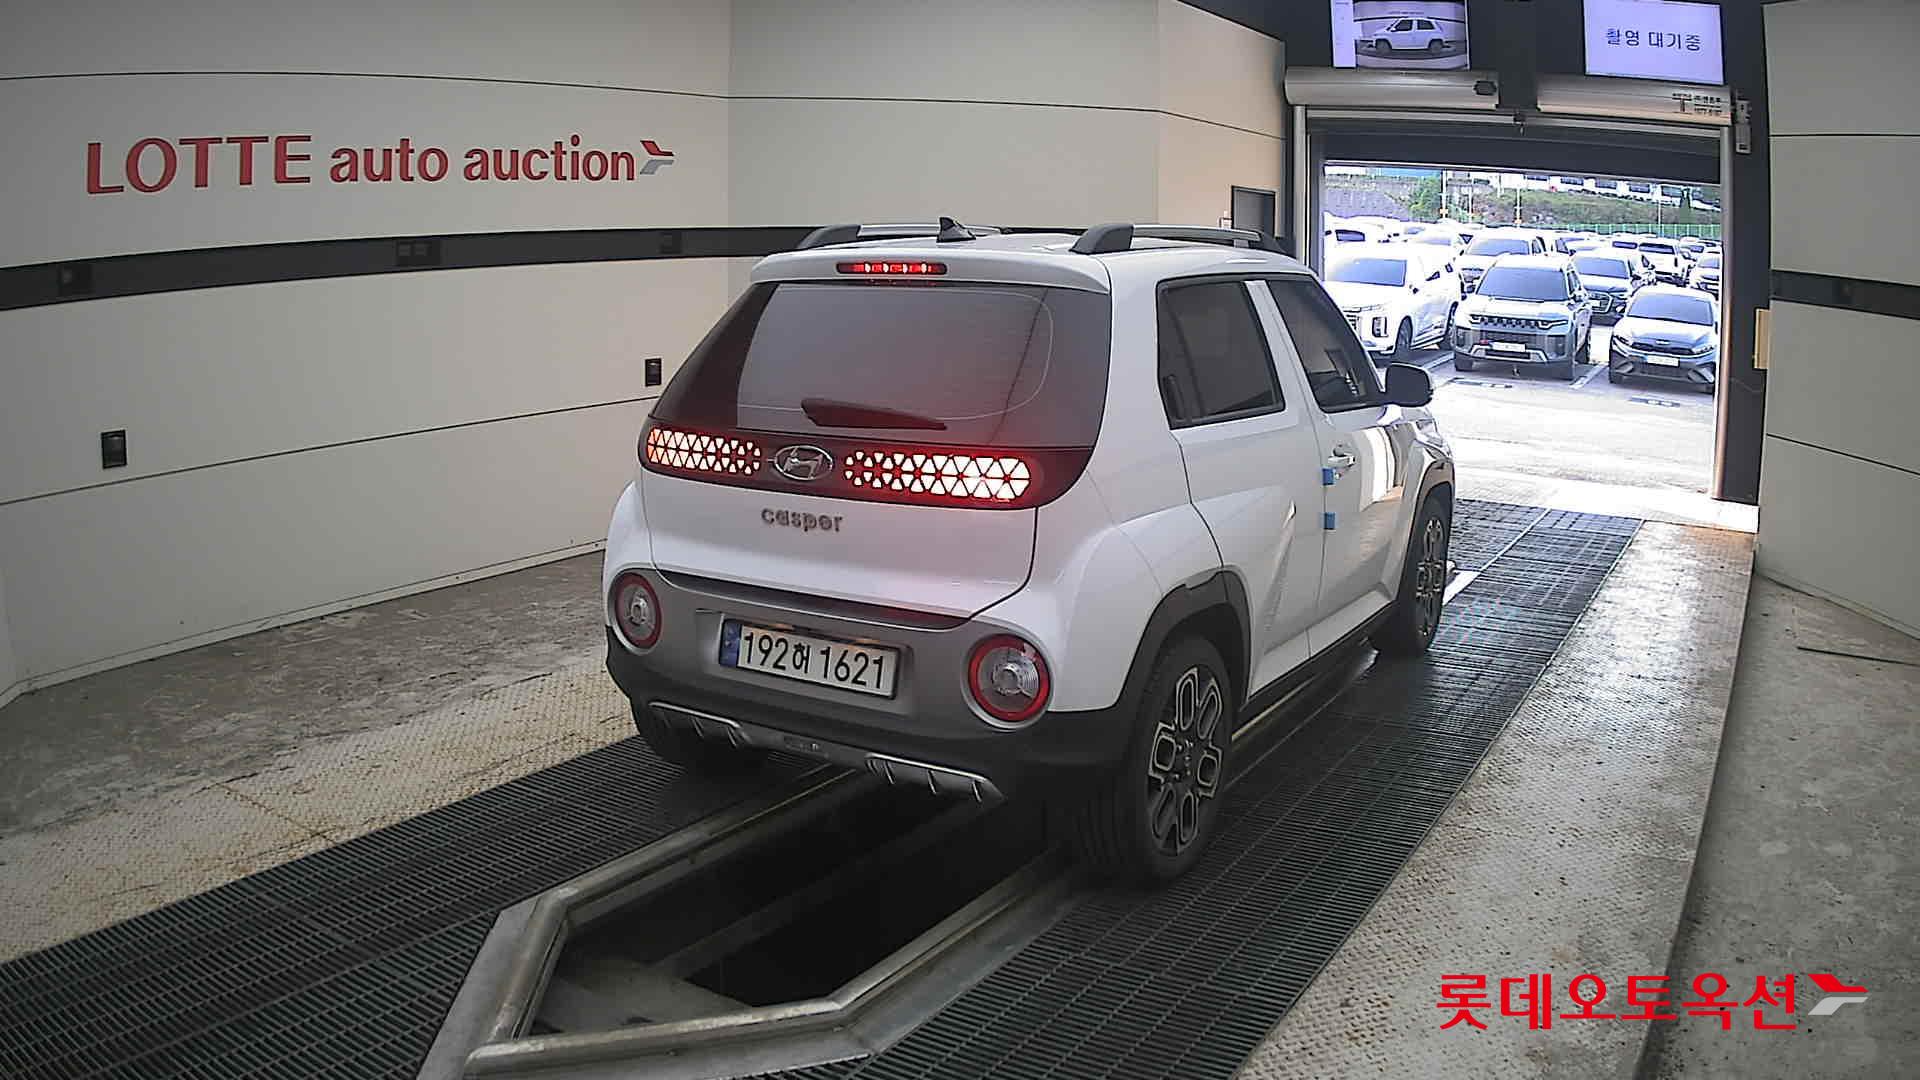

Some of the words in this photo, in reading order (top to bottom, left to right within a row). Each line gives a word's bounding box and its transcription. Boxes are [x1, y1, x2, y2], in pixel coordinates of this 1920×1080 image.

[1647, 31, 1701, 52] 대기중
[87, 135, 312, 195] LOTTE
[329, 137, 449, 183] auto
[463, 133, 636, 182] auction
[761, 507, 843, 533] casper
[743, 631, 811, 675] 192허
[820, 646, 884, 690] 1621
